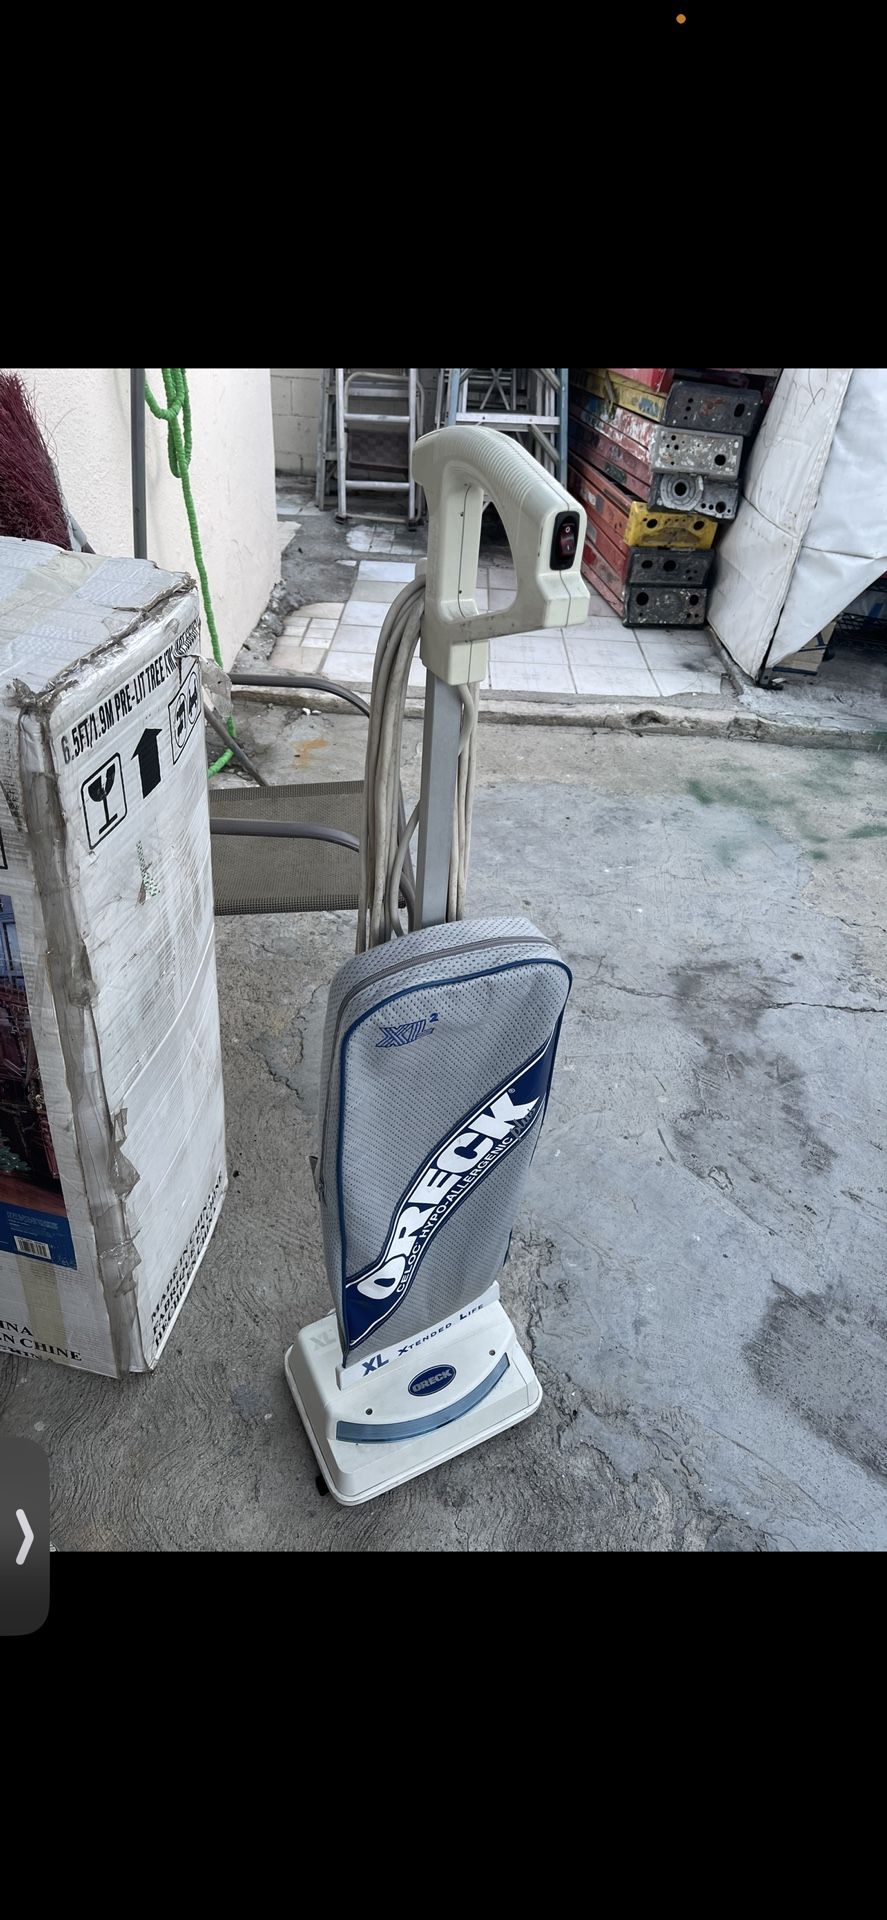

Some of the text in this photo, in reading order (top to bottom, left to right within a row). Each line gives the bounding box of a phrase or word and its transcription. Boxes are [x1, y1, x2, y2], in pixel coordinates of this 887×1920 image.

[61, 656, 166, 765] 6.5FT/1.9M PRE-LIT TREE
[357, 1091, 541, 1300] ORECK
[419, 1136, 514, 1239] HYPO-ALLERGENIC
[0, 1321, 34, 1337] INA
[20, 1338, 82, 1361] CHINE
[361, 1353, 390, 1377] XL
[412, 1369, 453, 1393] ORECK
